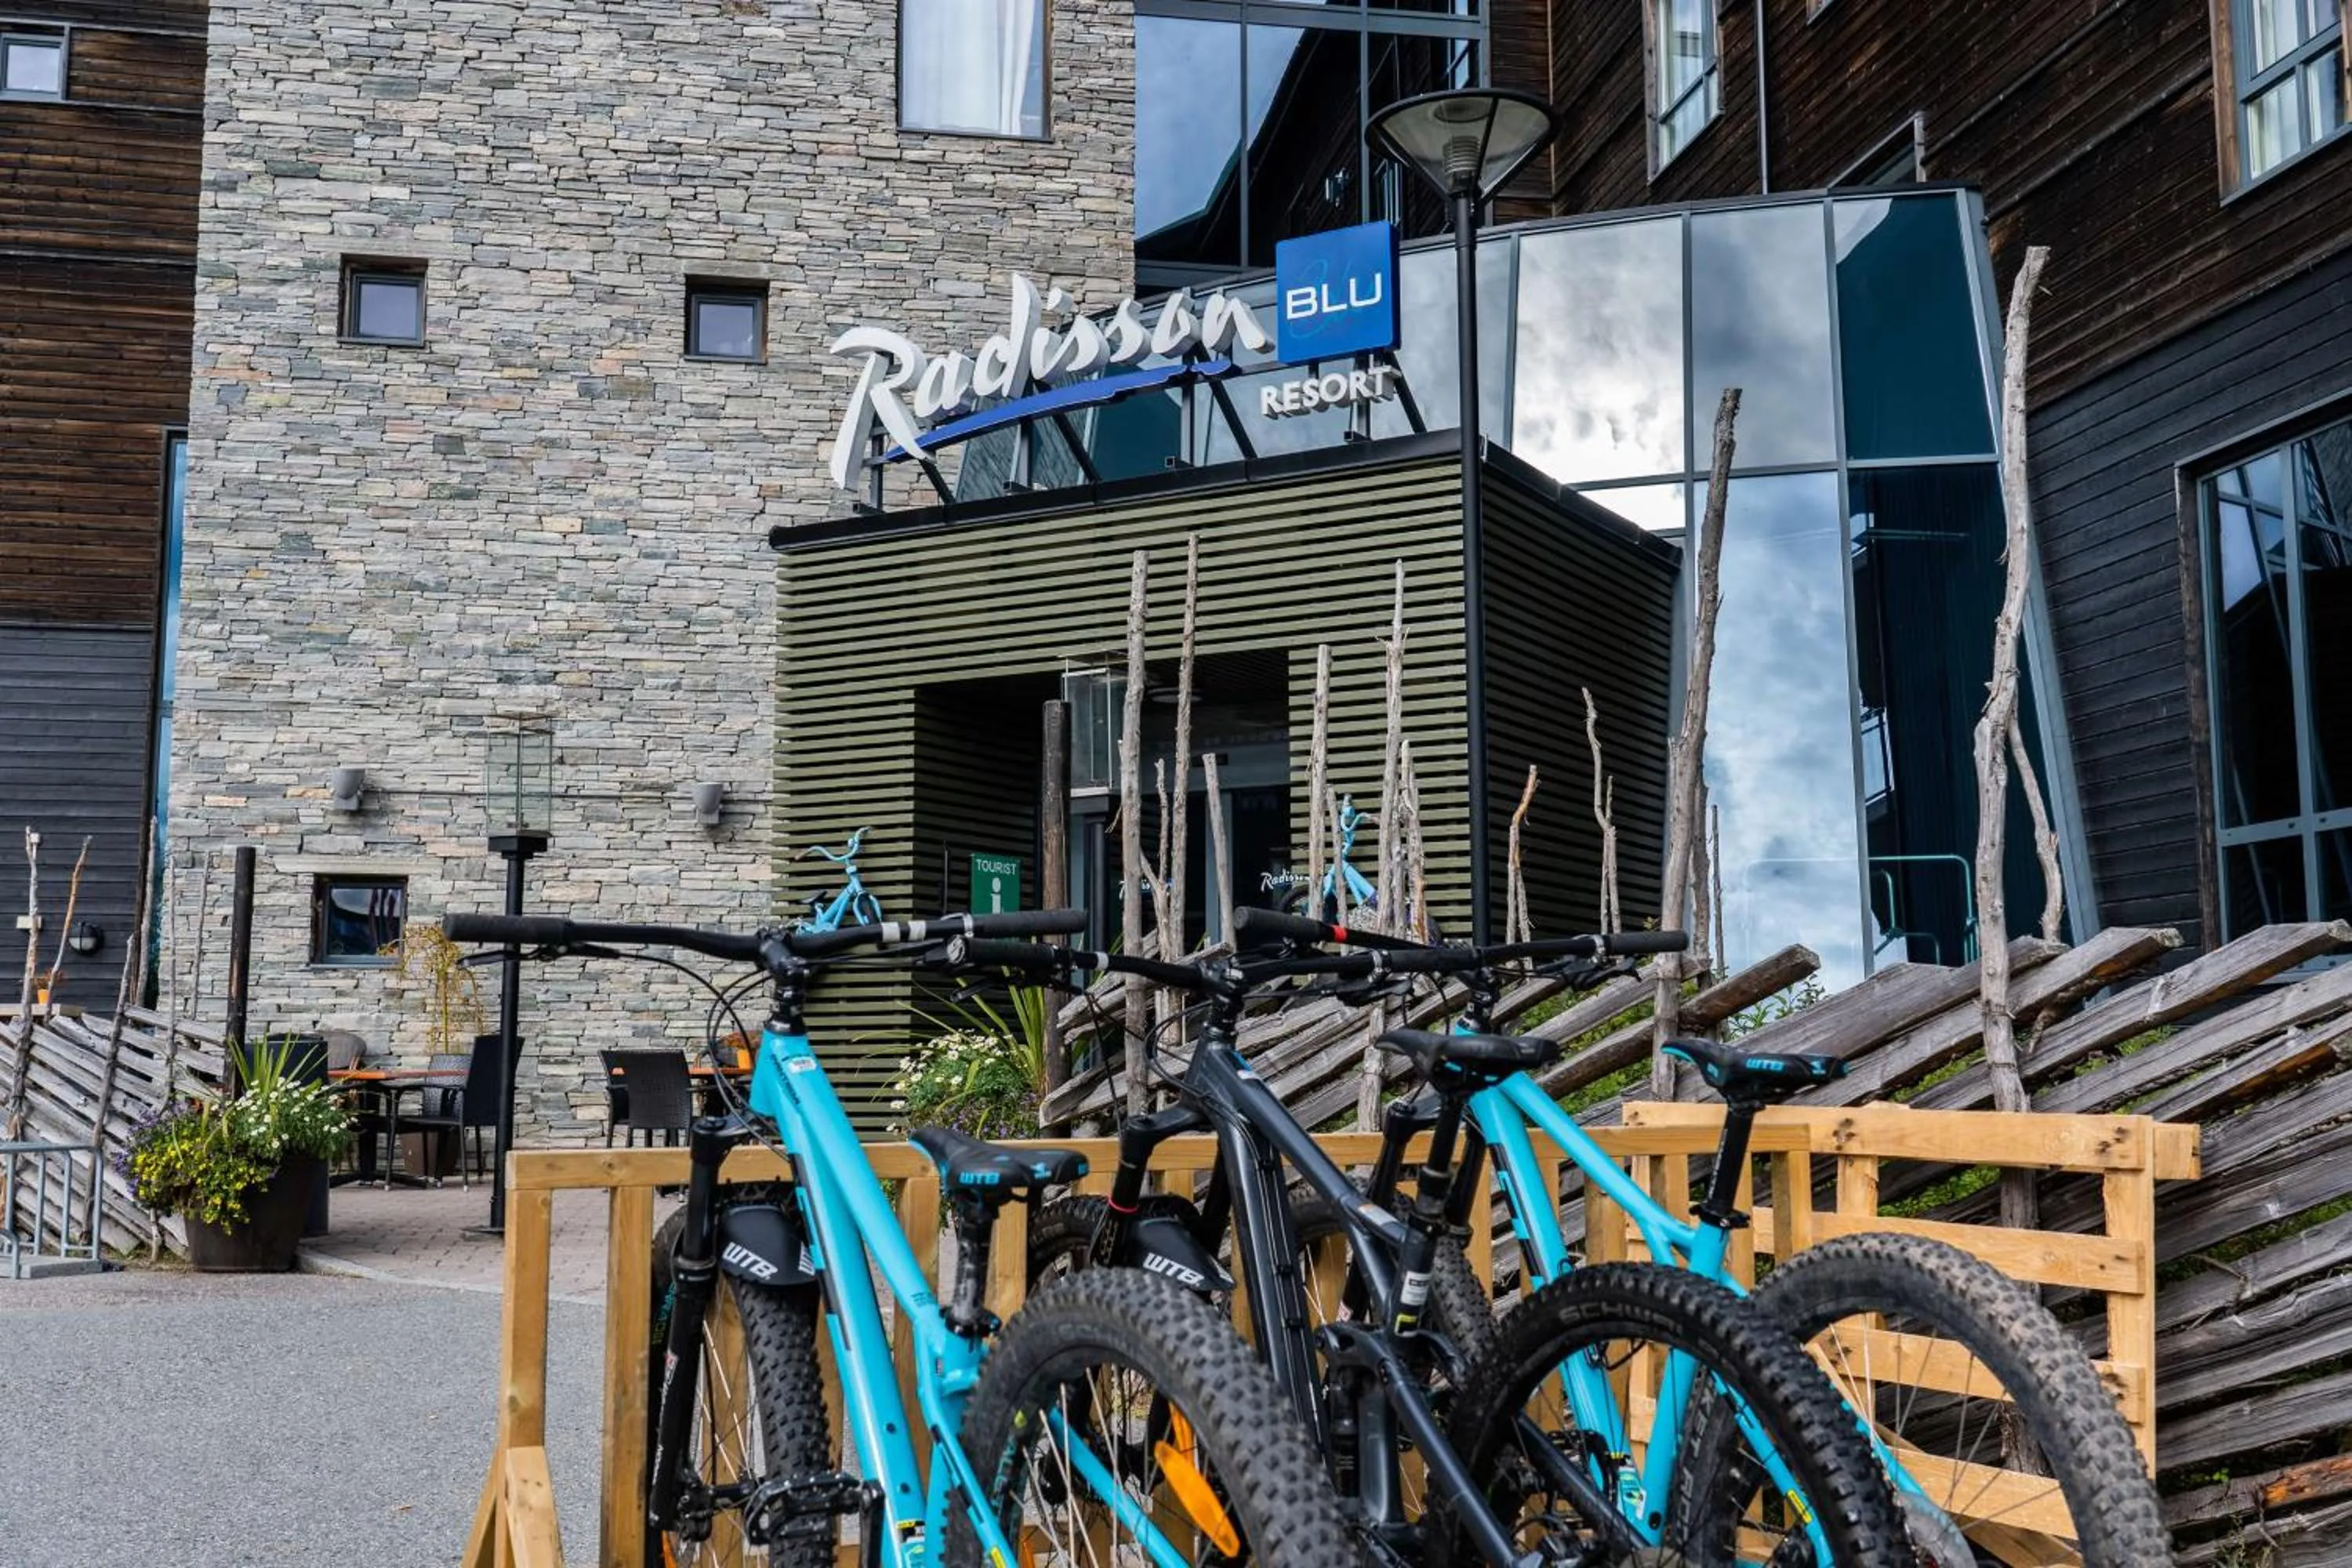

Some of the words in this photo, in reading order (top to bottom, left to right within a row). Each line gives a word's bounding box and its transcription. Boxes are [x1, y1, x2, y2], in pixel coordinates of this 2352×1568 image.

[1286, 272, 1382, 320] BLU
[829, 272, 1275, 489] Radisson
[1260, 362, 1396, 416] RESORT
[975, 858, 1017, 875] TOURIST
[1744, 1058, 1784, 1072] WTB
[959, 1171, 1001, 1185] WTB
[721, 1241, 779, 1280] WTB
[1142, 1252, 1205, 1287] WTB
